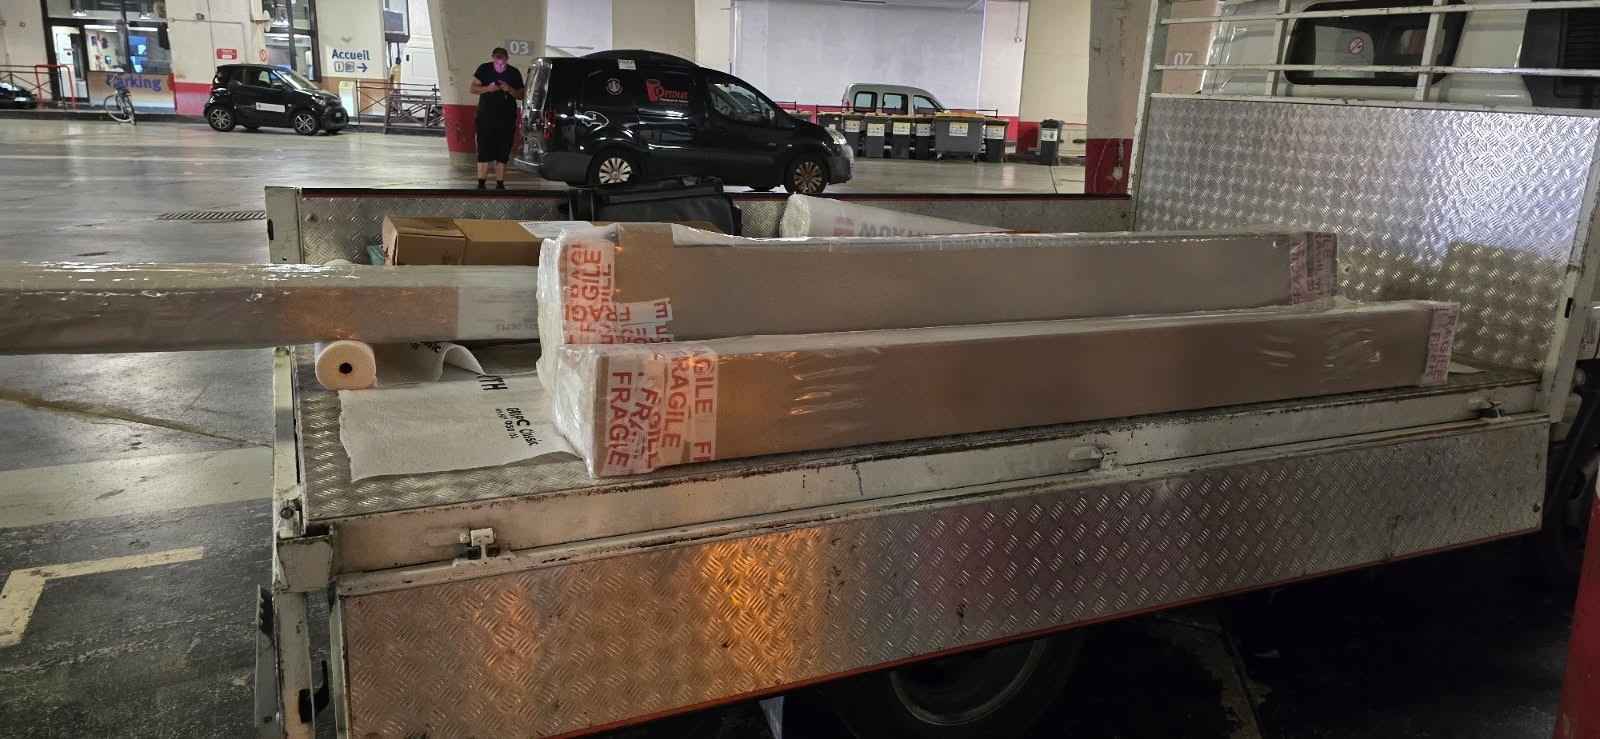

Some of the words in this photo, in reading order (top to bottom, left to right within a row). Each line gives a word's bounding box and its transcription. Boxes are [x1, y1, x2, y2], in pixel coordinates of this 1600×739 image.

[331, 49, 370, 61] Accueil
[510, 41, 529, 55] 03
[662, 357, 690, 449] RAGILE
